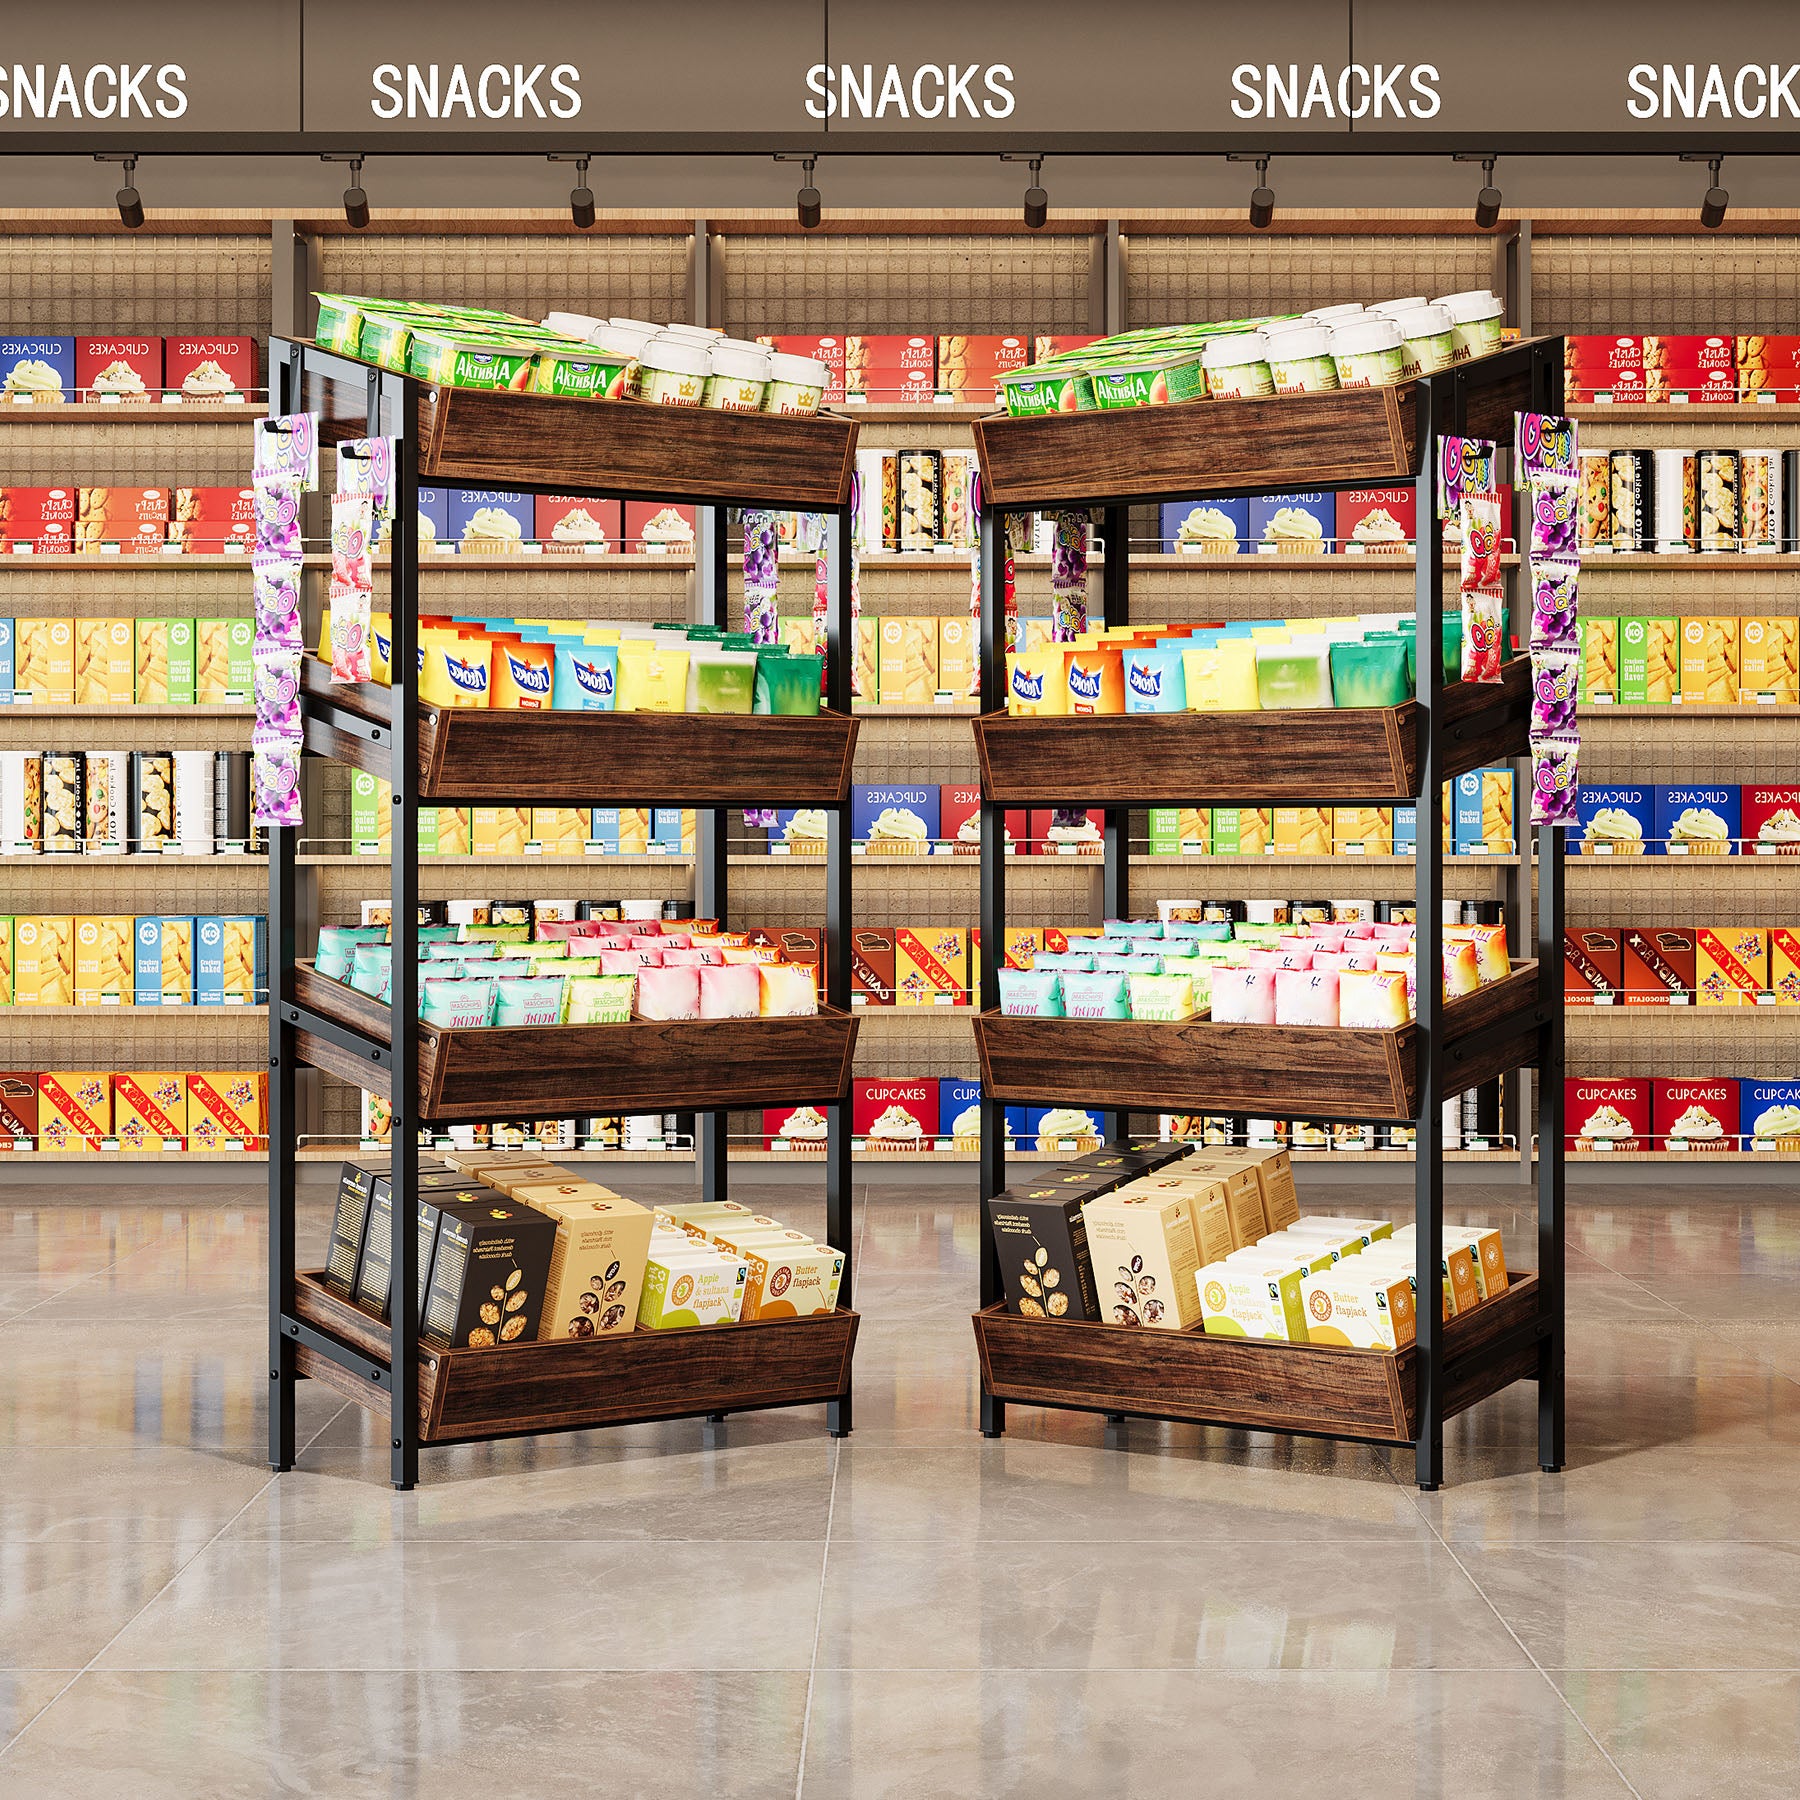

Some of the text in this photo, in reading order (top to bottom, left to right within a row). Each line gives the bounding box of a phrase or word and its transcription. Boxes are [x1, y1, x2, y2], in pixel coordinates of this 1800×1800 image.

[371, 64, 582, 119] SNACKS
[805, 64, 1016, 119] SNACKS
[1230, 64, 1441, 119] SNACKS
[866, 1088, 926, 1101] CUPCAKES
[1576, 1088, 1637, 1101] CUPCAKES
[1666, 1088, 1727, 1101] CUPCAKES
[796, 1265, 819, 1275] Butter
[698, 1273, 720, 1284] Apple
[793, 1276, 821, 1290] flapjack
[693, 1296, 722, 1310] flapjack
[1333, 1292, 1358, 1303] Butter
[1336, 1305, 1367, 1319] flapjack
